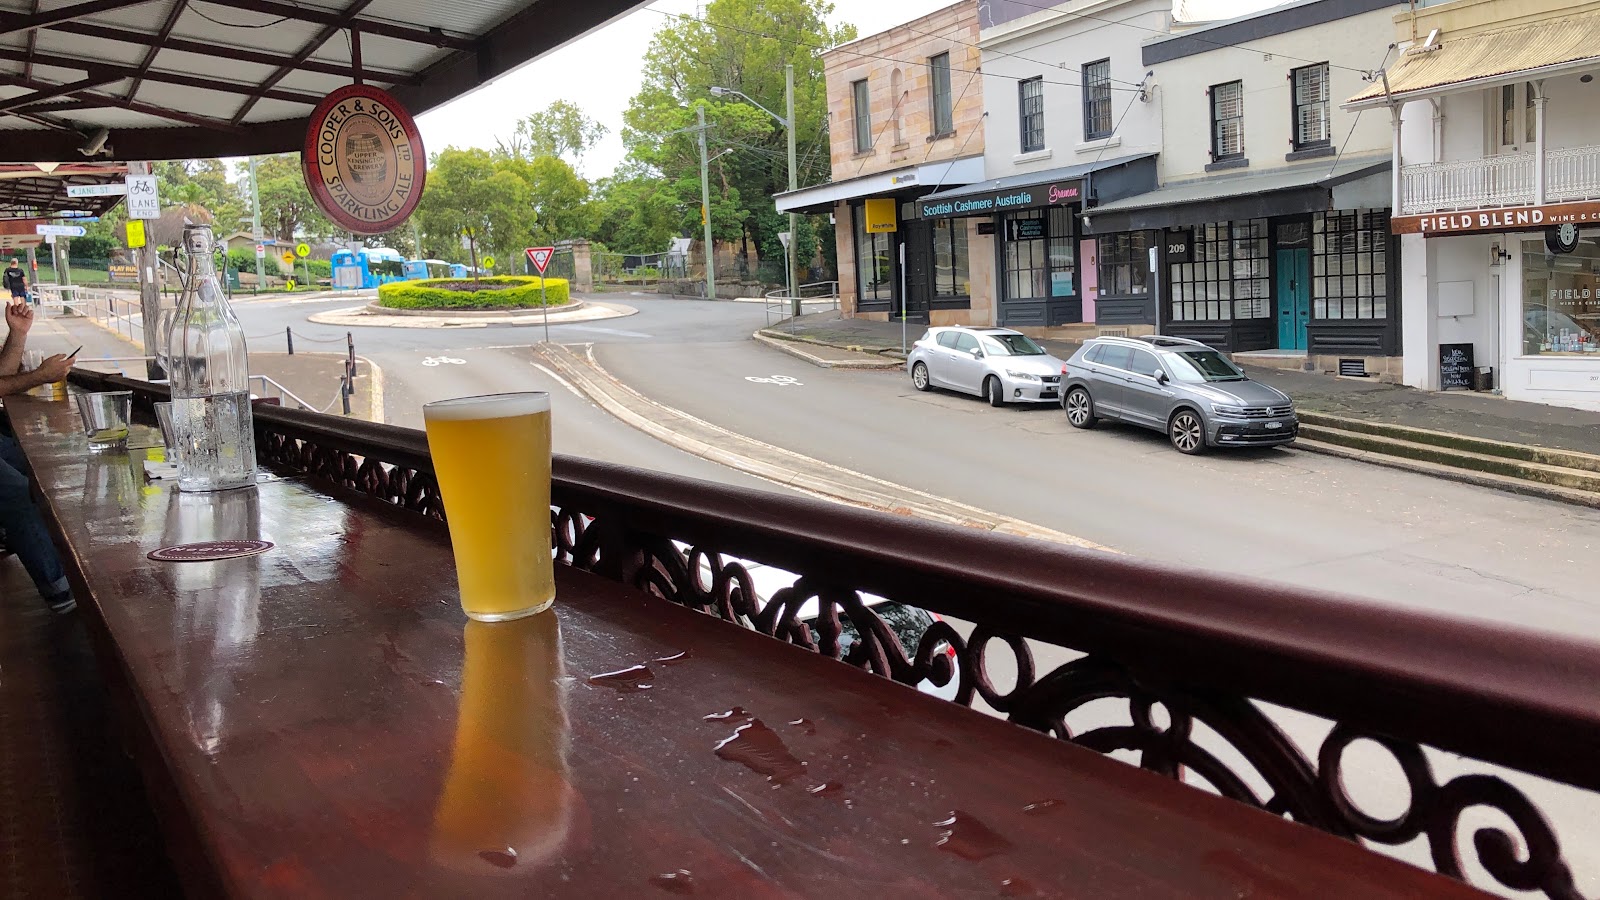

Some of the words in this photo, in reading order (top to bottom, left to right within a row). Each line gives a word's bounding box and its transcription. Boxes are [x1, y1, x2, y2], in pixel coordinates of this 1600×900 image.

[320, 104, 351, 166] COOPER
[354, 99, 365, 112] &
[368, 103, 404, 140] SONS
[347, 156, 384, 164] KENSINGTON
[78, 187, 96, 195] JANE
[99, 186, 108, 194] ST
[326, 175, 400, 220] SPARKLING
[395, 172, 412, 200] ALE
[131, 199, 157, 208] LANE
[923, 203, 953, 217] Scottish
[954, 199, 992, 213] Cashmere
[995, 192, 1032, 207] Australia
[1420, 214, 1472, 232] FIELD
[1479, 209, 1544, 227] BLEND
[1550, 214, 1576, 222] WINE
[1168, 244, 1186, 254] 209
[1550, 288, 1591, 300] FIELD
